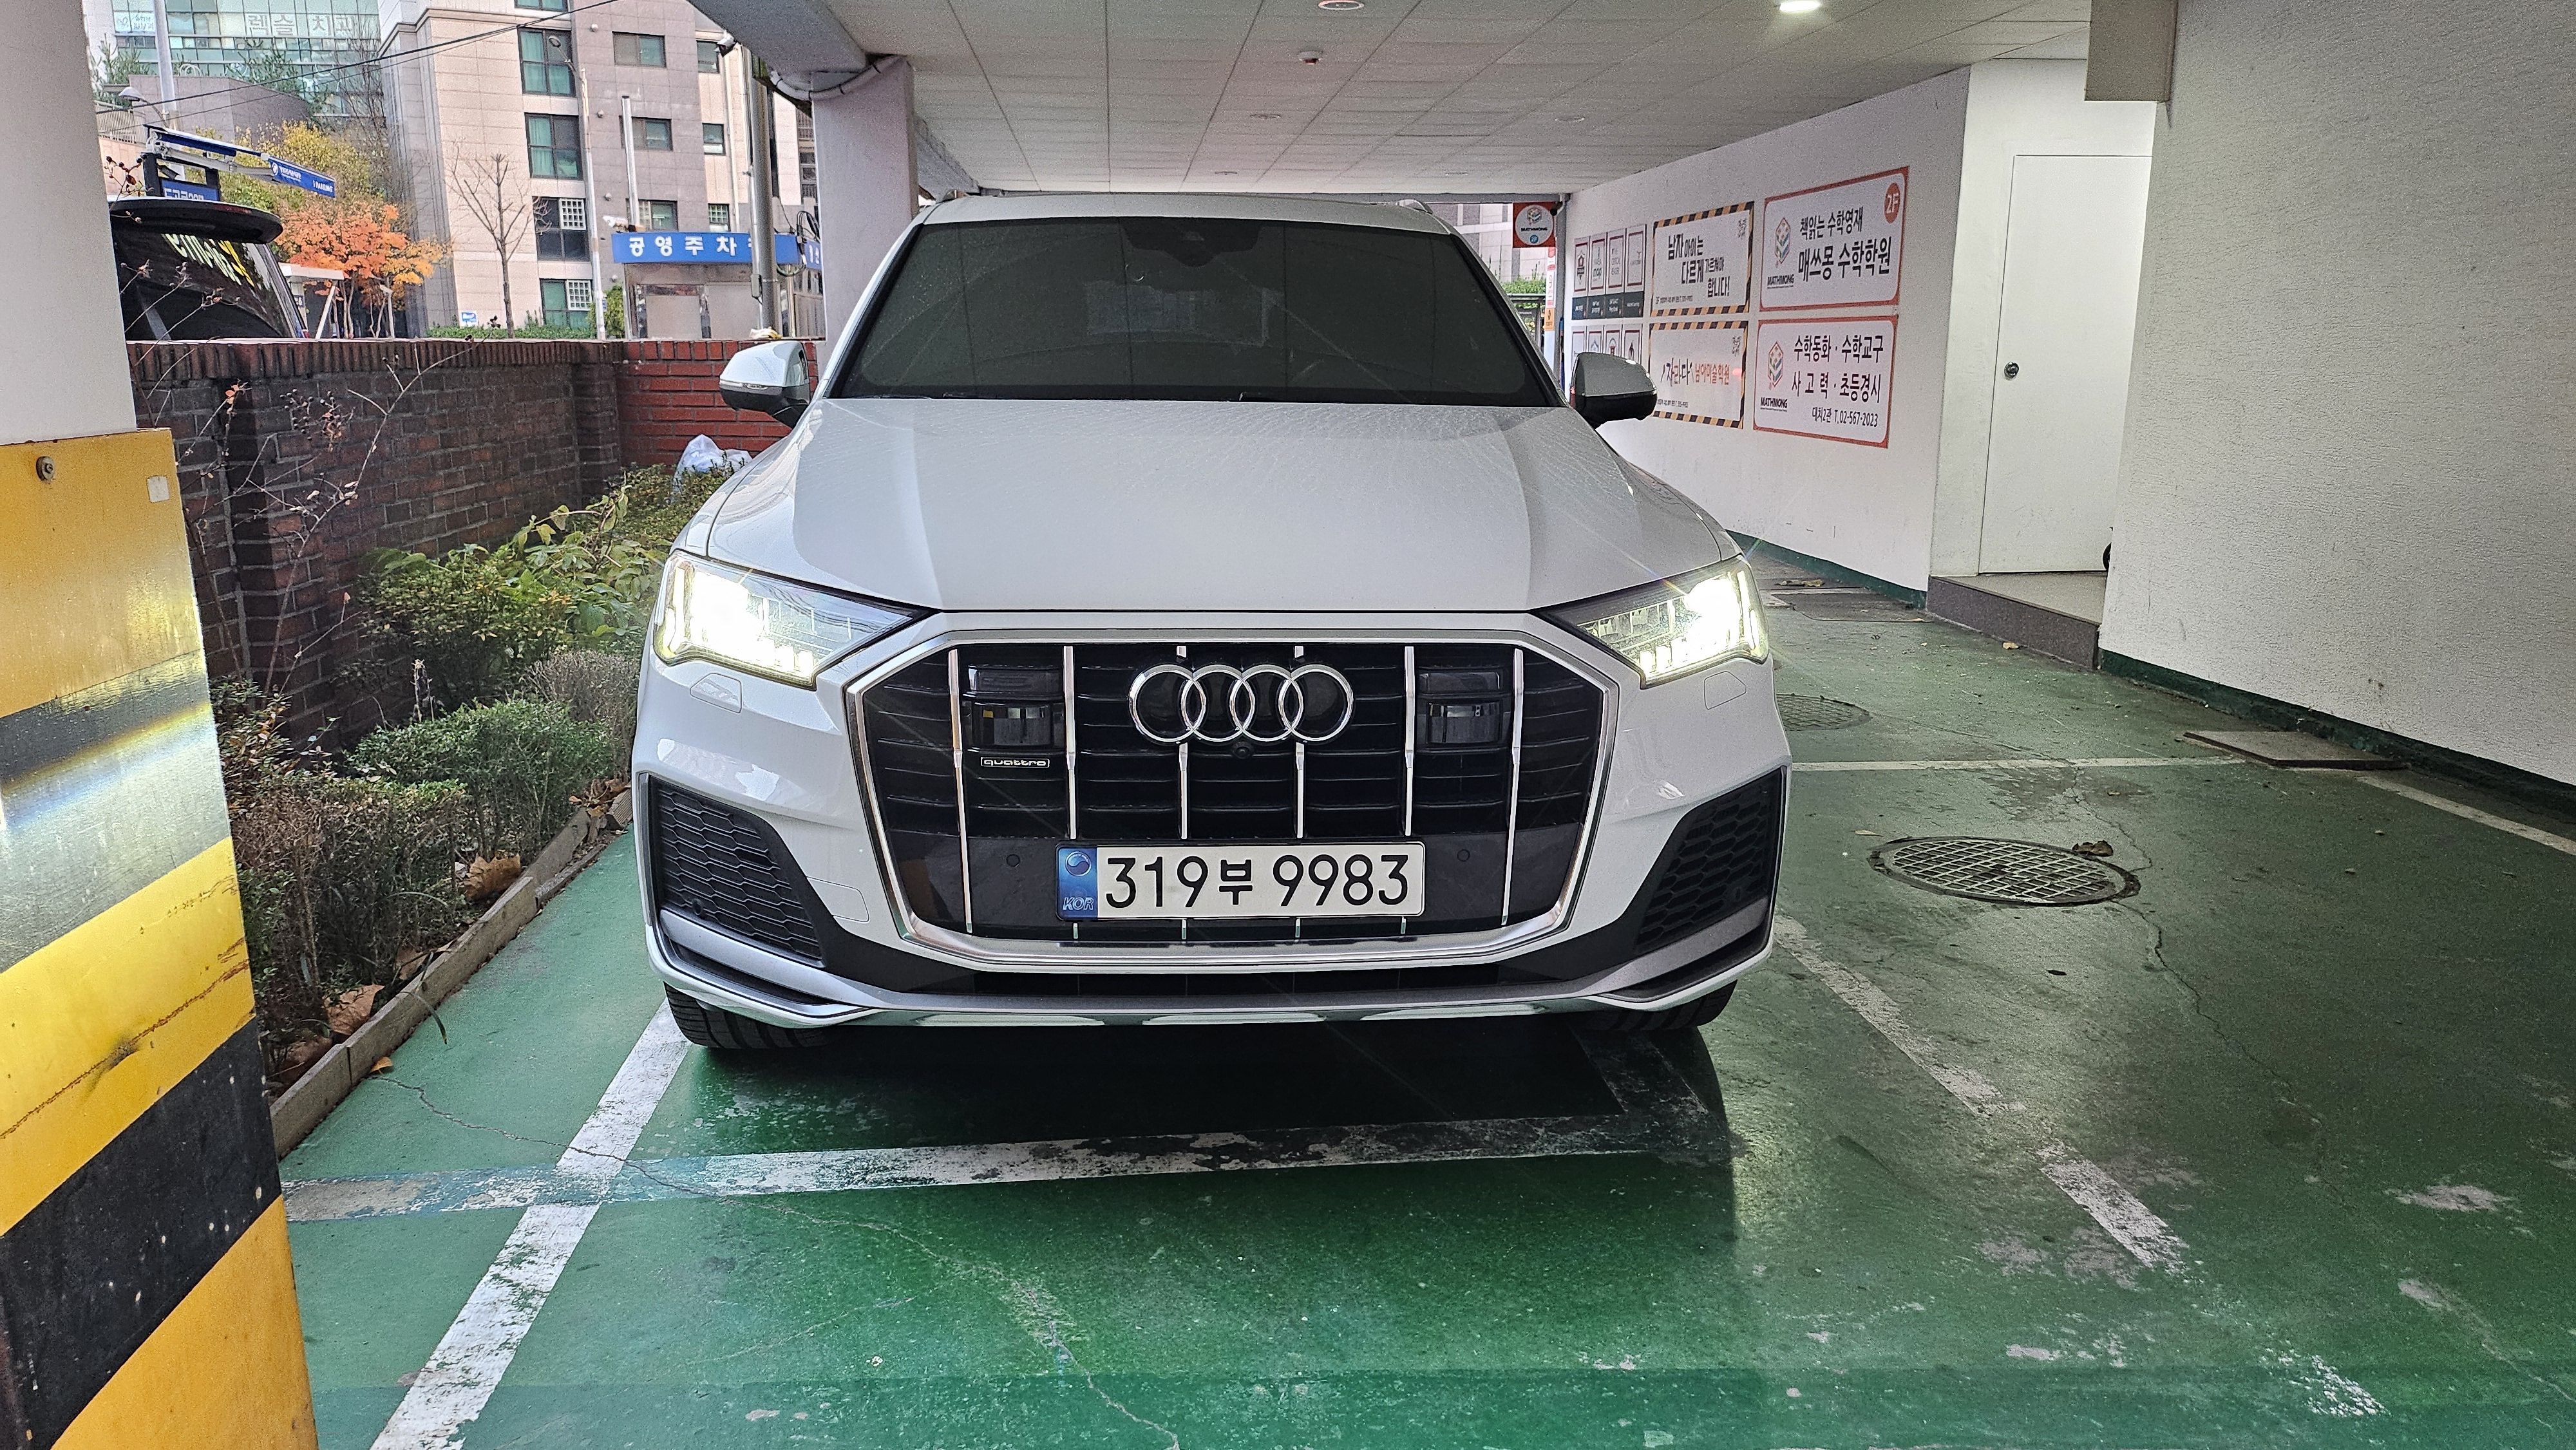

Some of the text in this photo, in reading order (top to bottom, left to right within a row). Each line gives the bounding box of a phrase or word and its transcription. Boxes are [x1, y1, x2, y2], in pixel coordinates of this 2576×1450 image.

[248, 14, 294, 35] 렉슬
[1886, 193, 1899, 214] 2F
[1800, 206, 1864, 241] 책읽는 수학영재
[629, 236, 752, 258] 공영주차
[1798, 236, 1892, 282] 매쓰몽 수학학원
[1681, 259, 1704, 284] 다르게
[1767, 274, 1795, 286] MATHMONG
[1707, 276, 1730, 298] 합니다!
[1794, 334, 1884, 364] 수학동화 수학교구
[1839, 373, 1881, 404] 초등경시
[1760, 397, 1788, 409] MATHMONG
[1812, 406, 1879, 428] 대치2관 T.02-567-2023
[1105, 854, 1410, 909] 319부 9983
[1063, 897, 1094, 910] KOR
